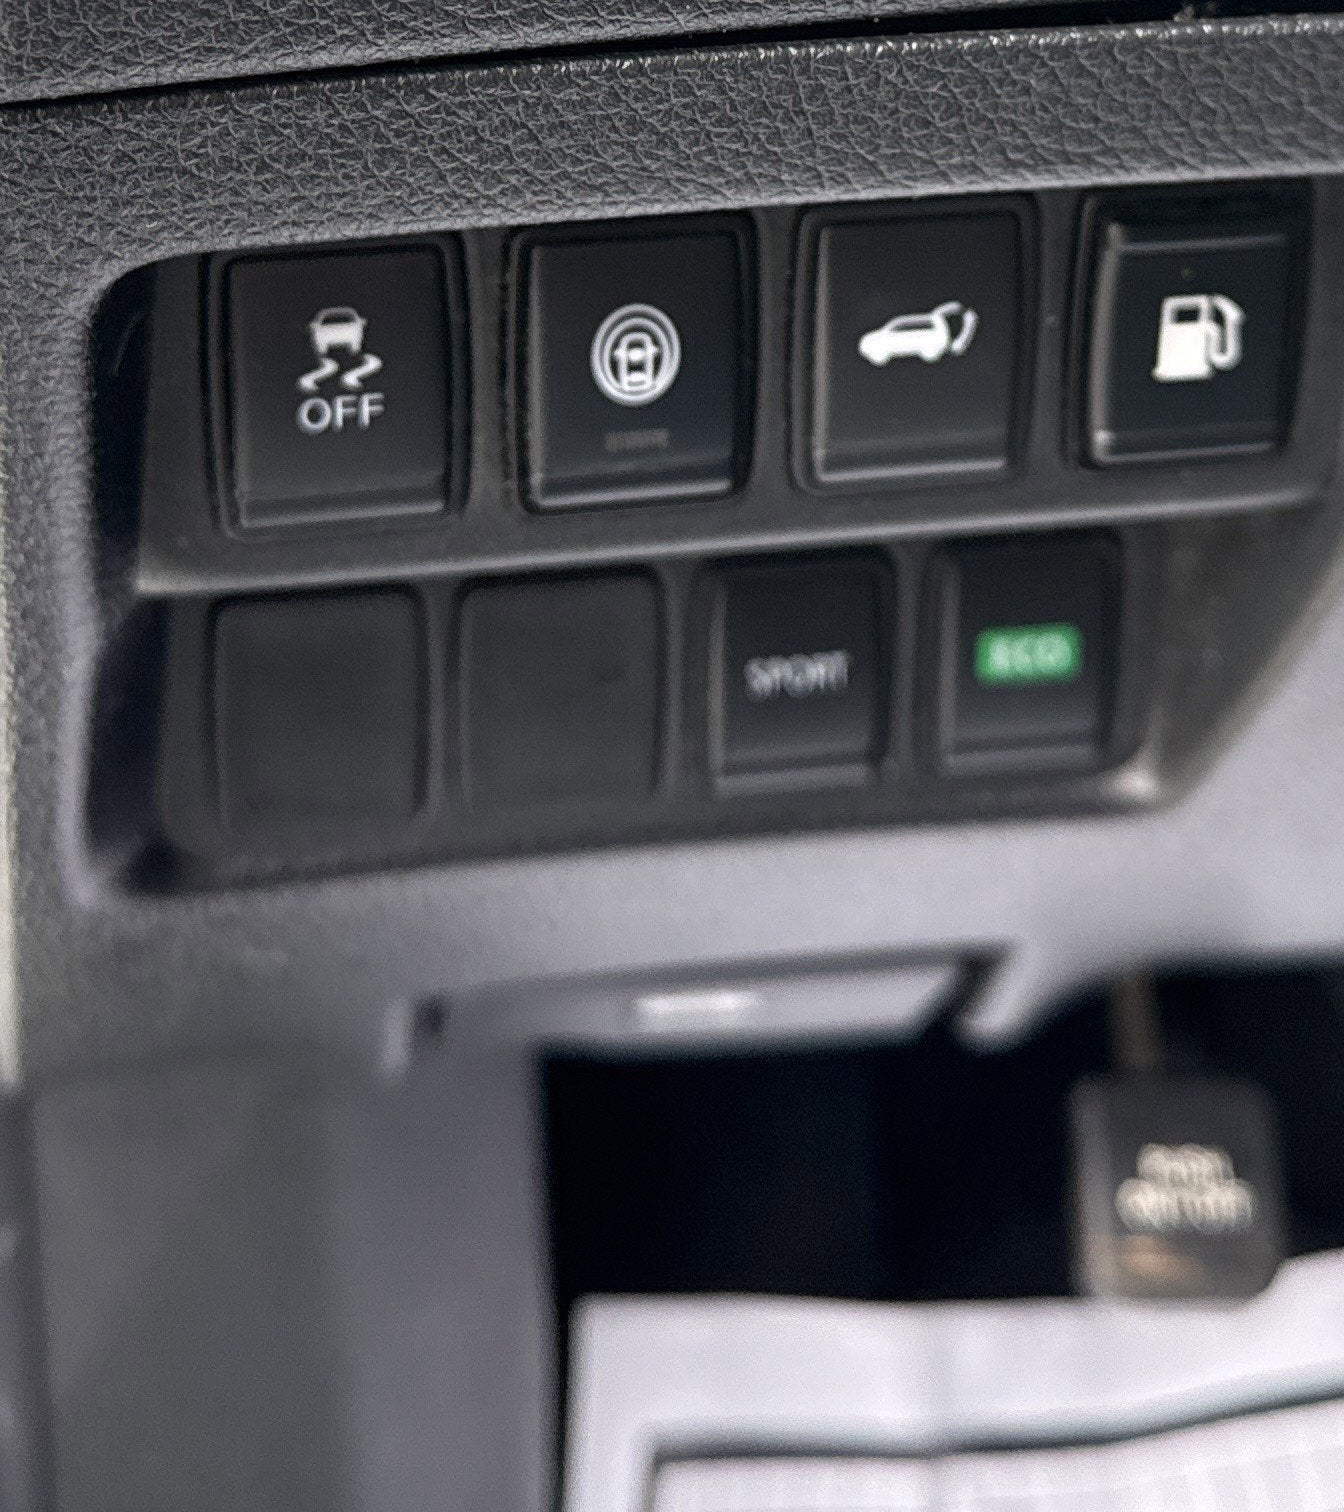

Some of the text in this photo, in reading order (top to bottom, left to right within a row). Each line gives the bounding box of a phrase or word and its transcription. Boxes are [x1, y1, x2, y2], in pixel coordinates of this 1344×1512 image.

[296, 392, 385, 435] OFF
[744, 648, 852, 701] SPORT
[987, 633, 1074, 675] ECO
